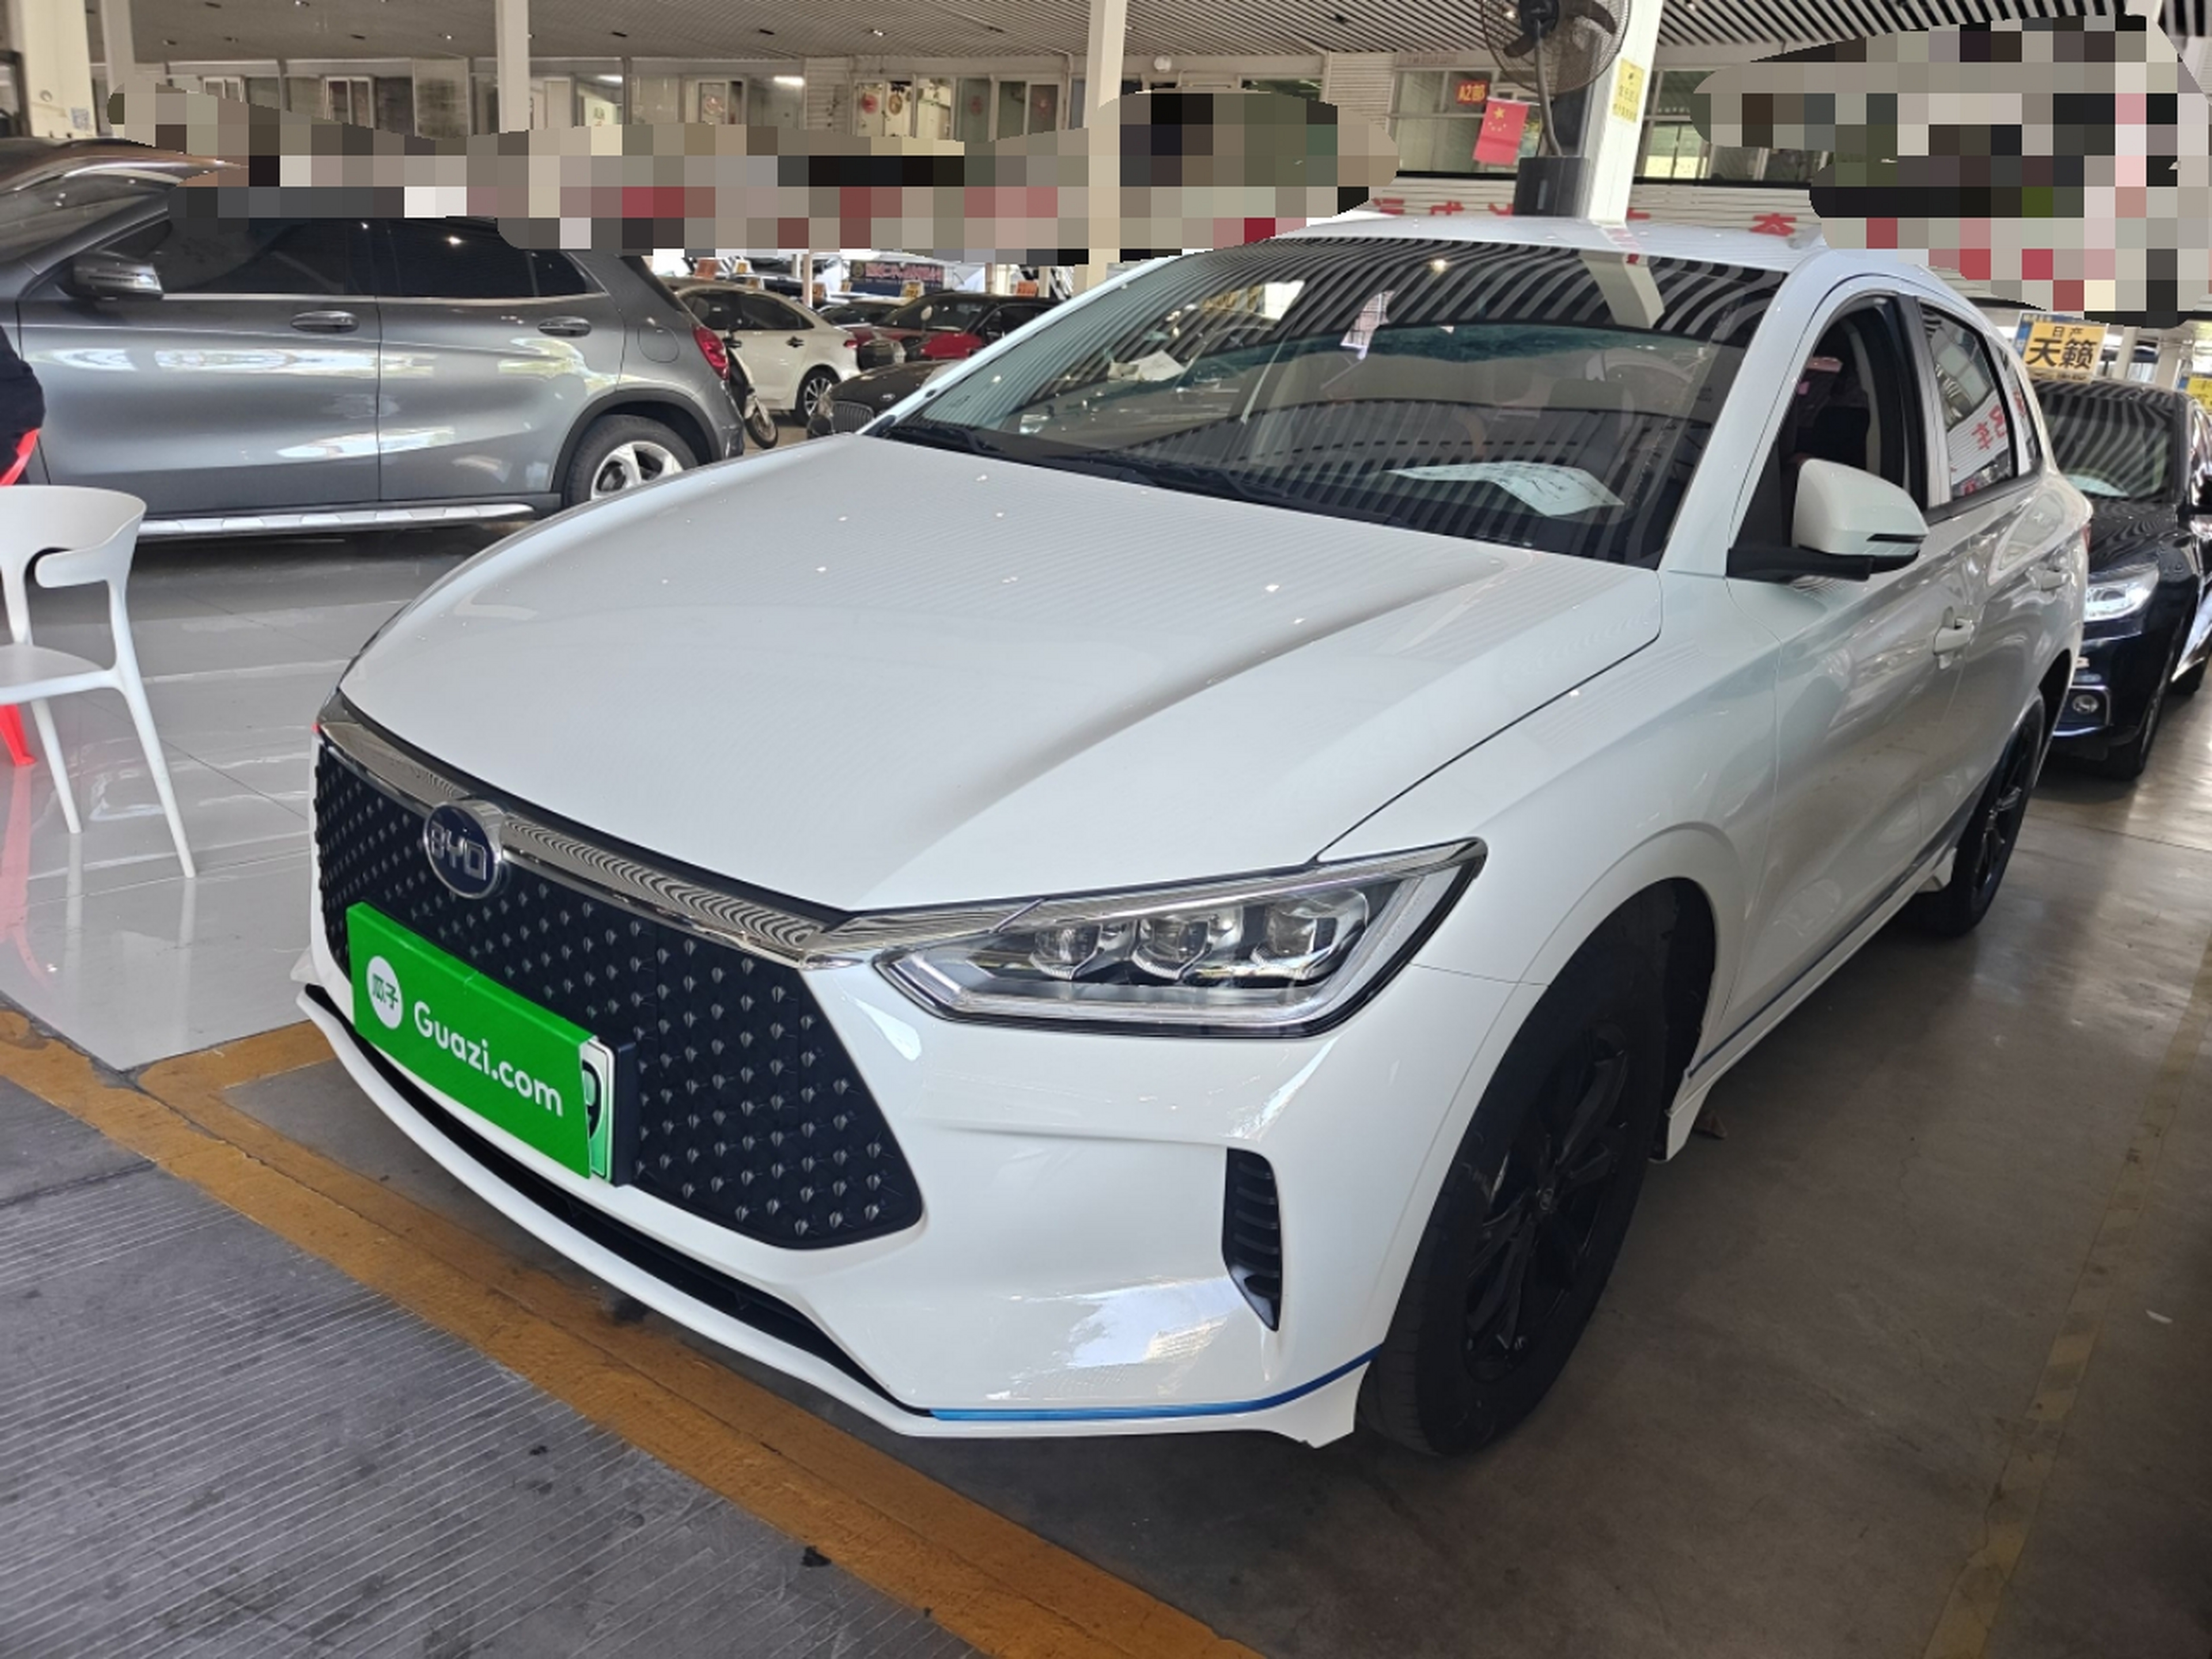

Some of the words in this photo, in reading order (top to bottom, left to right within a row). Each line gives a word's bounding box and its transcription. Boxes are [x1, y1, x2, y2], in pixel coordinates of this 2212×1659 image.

[2025, 338, 2098, 370] 天籁
[2052, 325, 2084, 338] 日产
[431, 819, 487, 881] BYD
[372, 973, 399, 1010] 瓜子
[414, 1001, 563, 1118] Guazi.com
